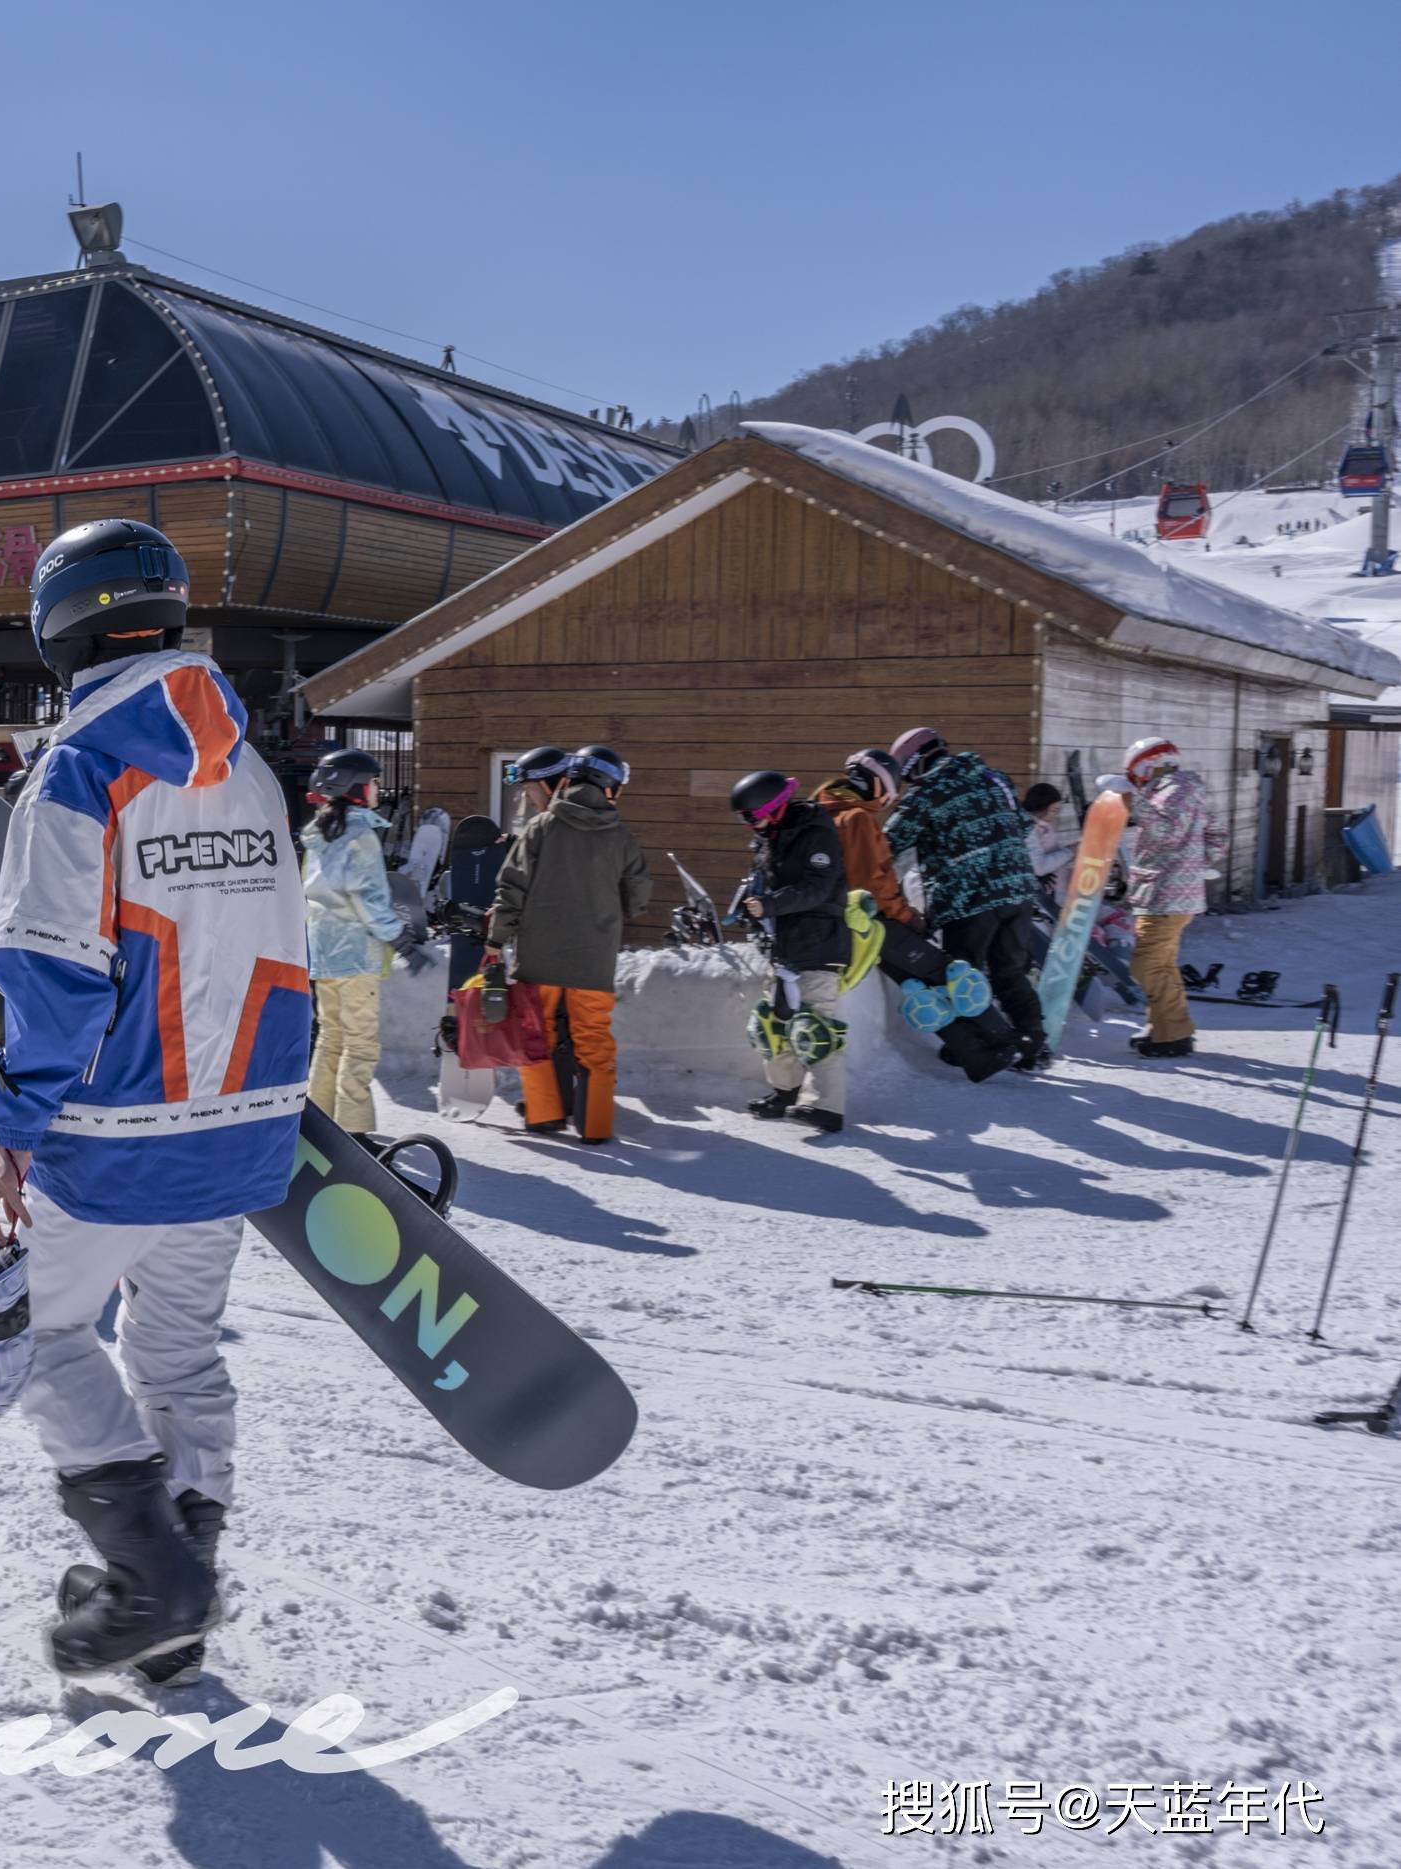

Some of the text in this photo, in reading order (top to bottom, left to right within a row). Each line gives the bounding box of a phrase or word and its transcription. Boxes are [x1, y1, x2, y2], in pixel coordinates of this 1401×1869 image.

[137, 829, 278, 880] PHENIX
[25, 928, 68, 944] PHENIX
[117, 1116, 158, 1125] PHENIX
[190, 1108, 223, 1119] PHENIX
[248, 1099, 275, 1109] PHENIX
